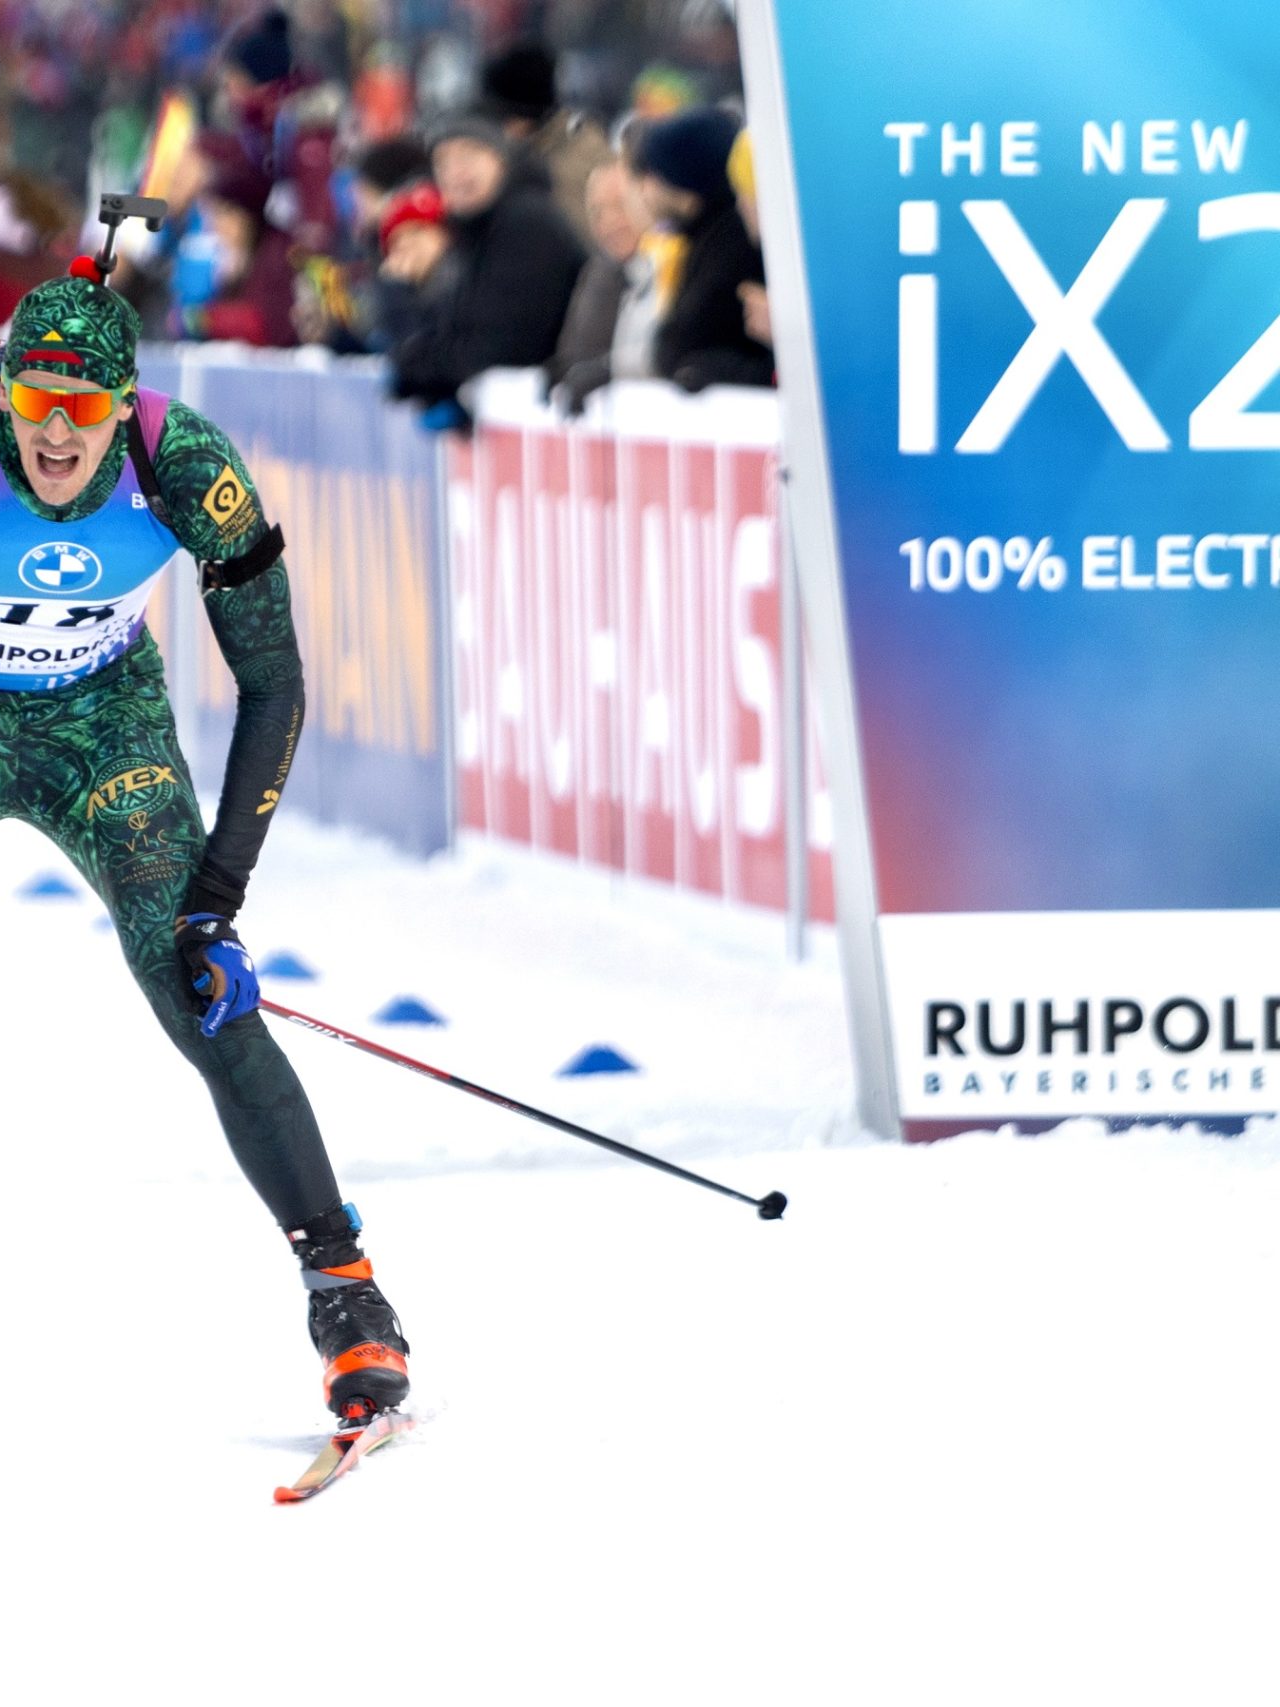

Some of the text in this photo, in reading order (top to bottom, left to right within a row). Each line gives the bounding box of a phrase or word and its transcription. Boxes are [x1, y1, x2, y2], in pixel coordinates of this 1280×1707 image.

[883, 118, 1249, 176] THE NEW
[31, 545, 91, 561] BMW
[899, 533, 1280, 592] 100% ELECT
[125, 829, 169, 852] VIC
[924, 1068, 1265, 1095] BAYERISCHE
